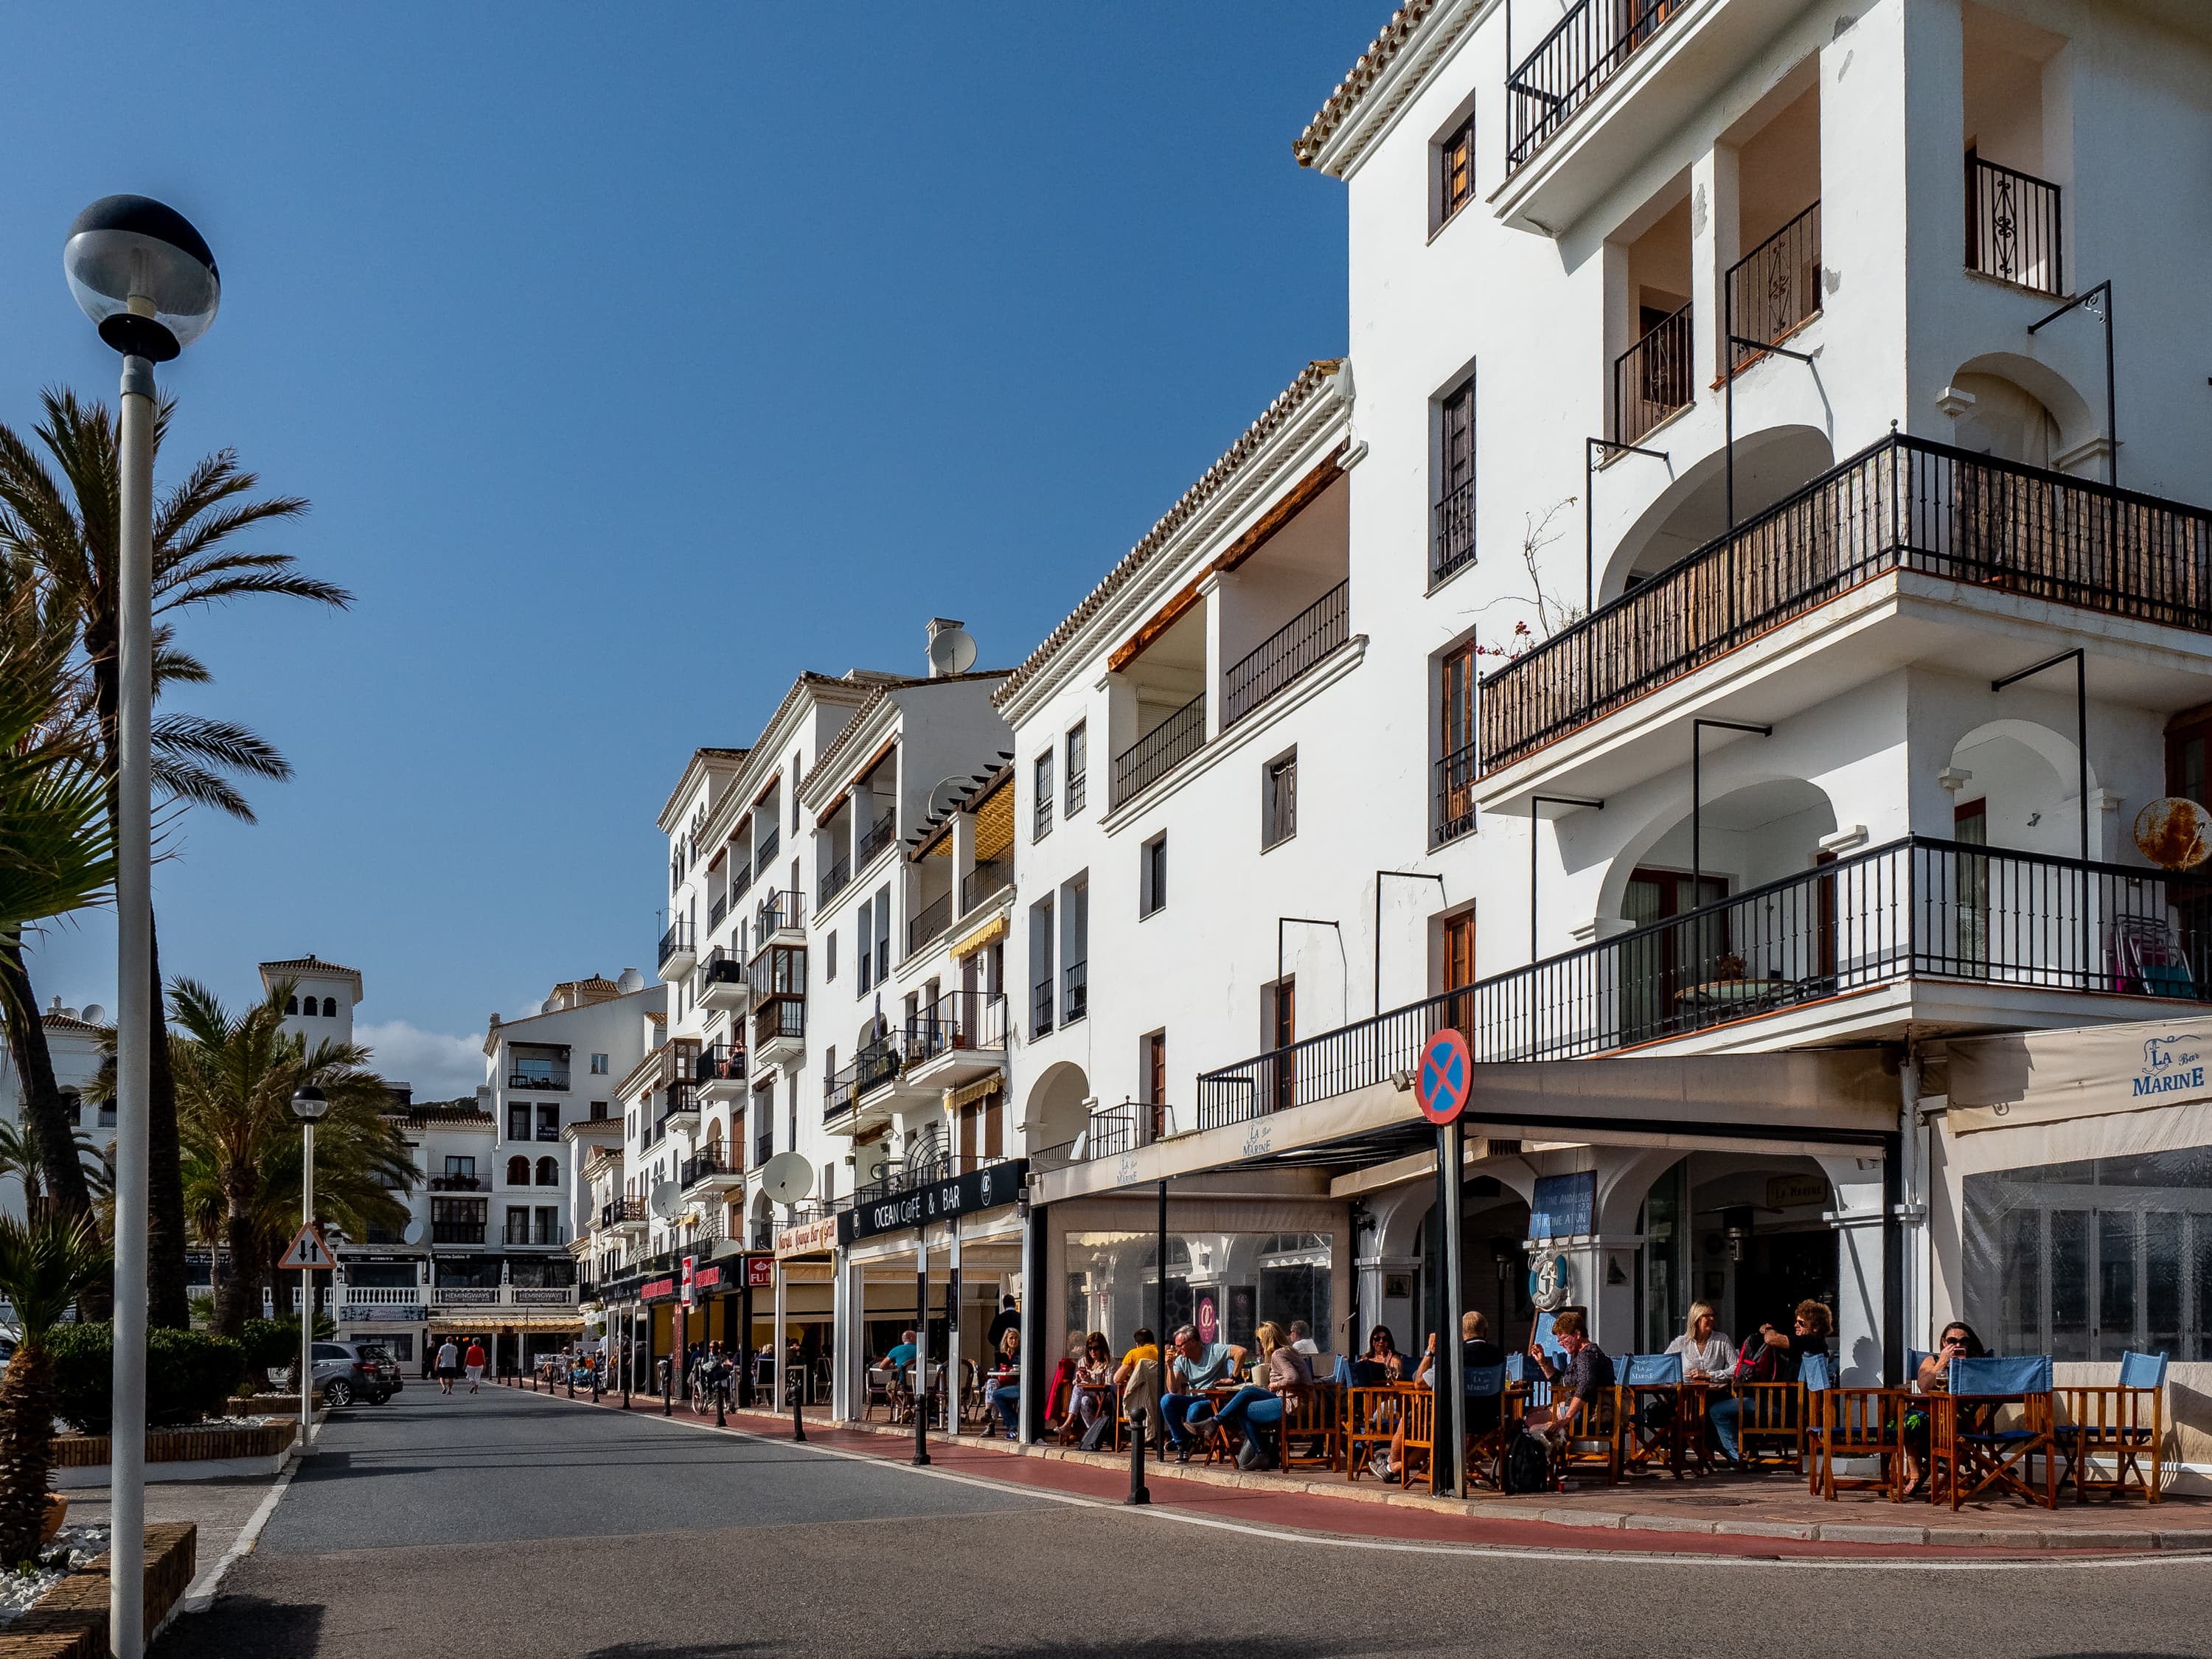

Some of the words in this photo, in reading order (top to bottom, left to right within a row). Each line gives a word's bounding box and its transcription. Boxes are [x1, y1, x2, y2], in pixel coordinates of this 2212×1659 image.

[2151, 1050, 2172, 1066] LA
[2178, 1053, 2200, 1066] Bar
[2132, 1067, 2205, 1097] MARINE
[1242, 1140, 1270, 1157] MARINE
[1116, 1171, 1137, 1186] MARINE
[874, 1202, 899, 1228] OCEAN
[900, 1192, 921, 1224] C@FÉ
[928, 1192, 935, 1215] &
[942, 1185, 960, 1211] BAR
